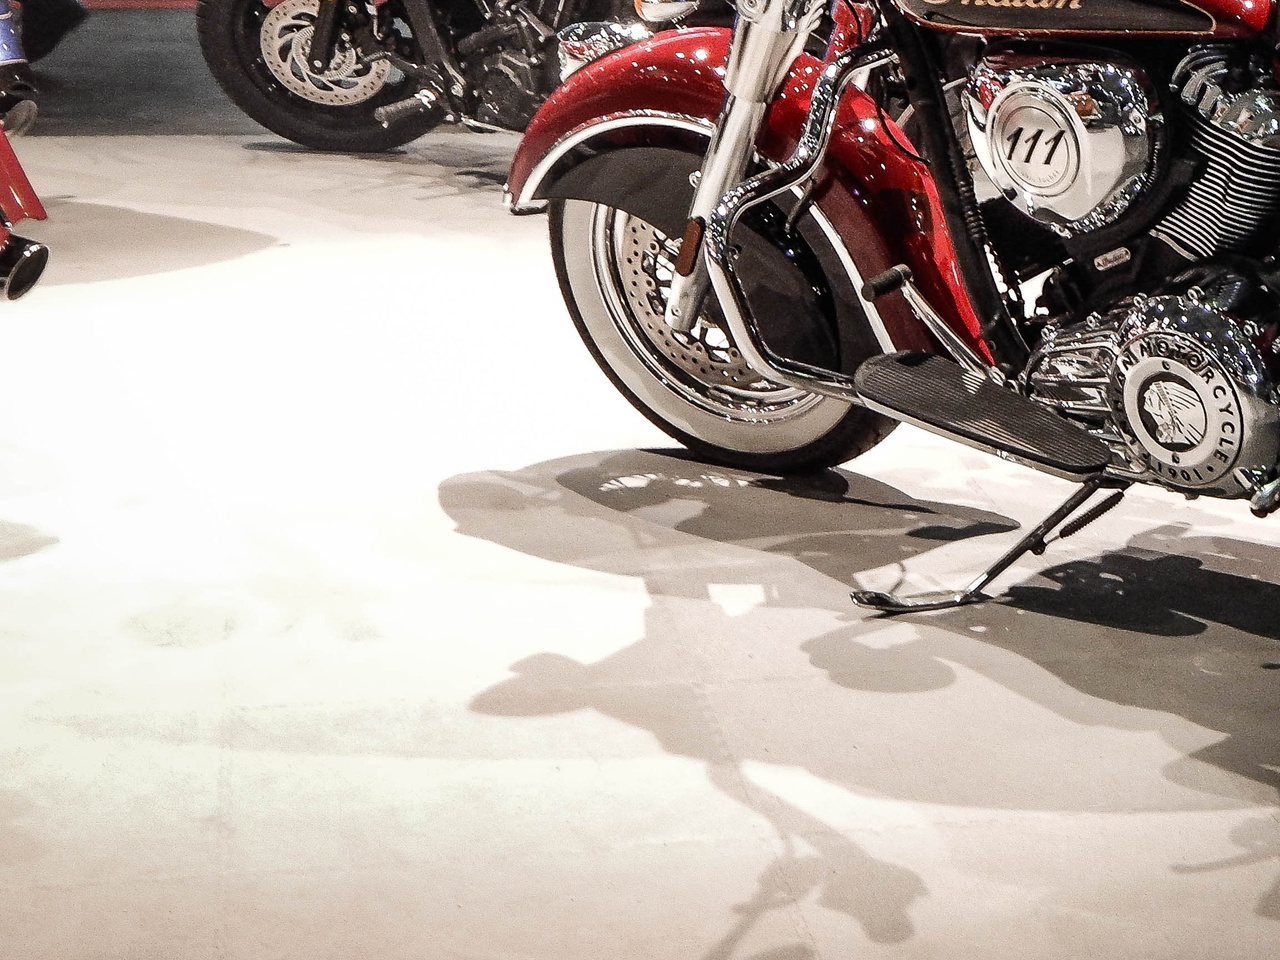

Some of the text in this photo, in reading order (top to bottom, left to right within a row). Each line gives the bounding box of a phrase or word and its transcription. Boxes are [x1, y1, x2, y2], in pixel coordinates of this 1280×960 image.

[1006, 126, 1066, 165] 111
[1139, 340, 1236, 464] MOTORCYCLE
[1157, 461, 1203, 482] 1901
